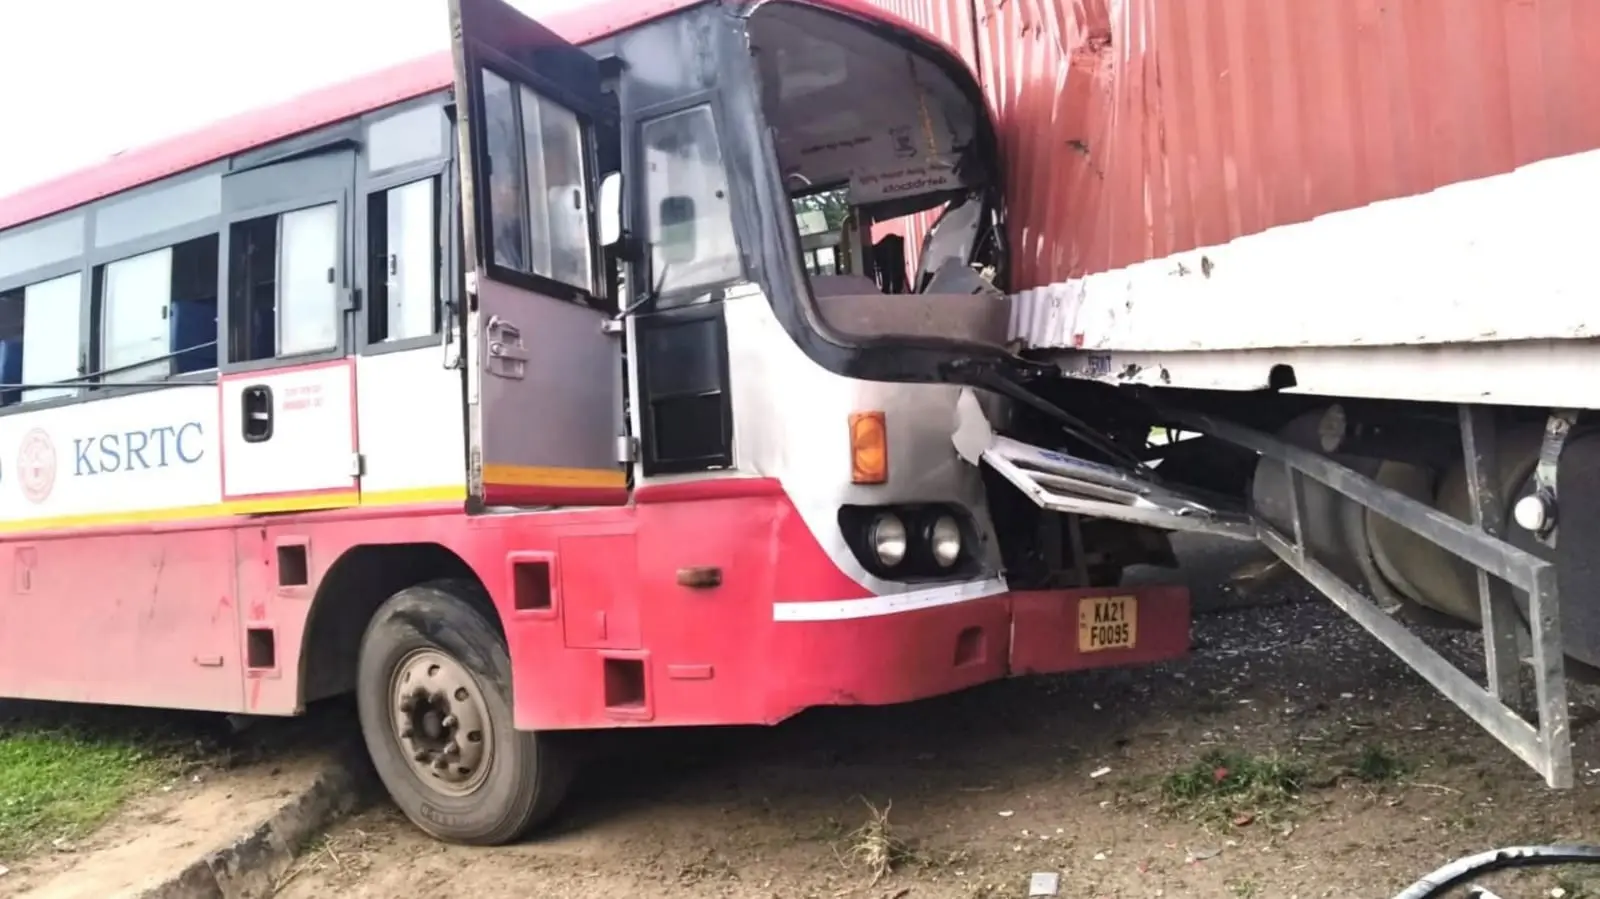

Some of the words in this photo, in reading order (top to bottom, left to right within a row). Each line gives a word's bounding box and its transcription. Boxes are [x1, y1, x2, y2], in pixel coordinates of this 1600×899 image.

[74, 421, 205, 476] KSRTC
[1094, 601, 1125, 623] KA21
[1090, 622, 1129, 647] F0095
